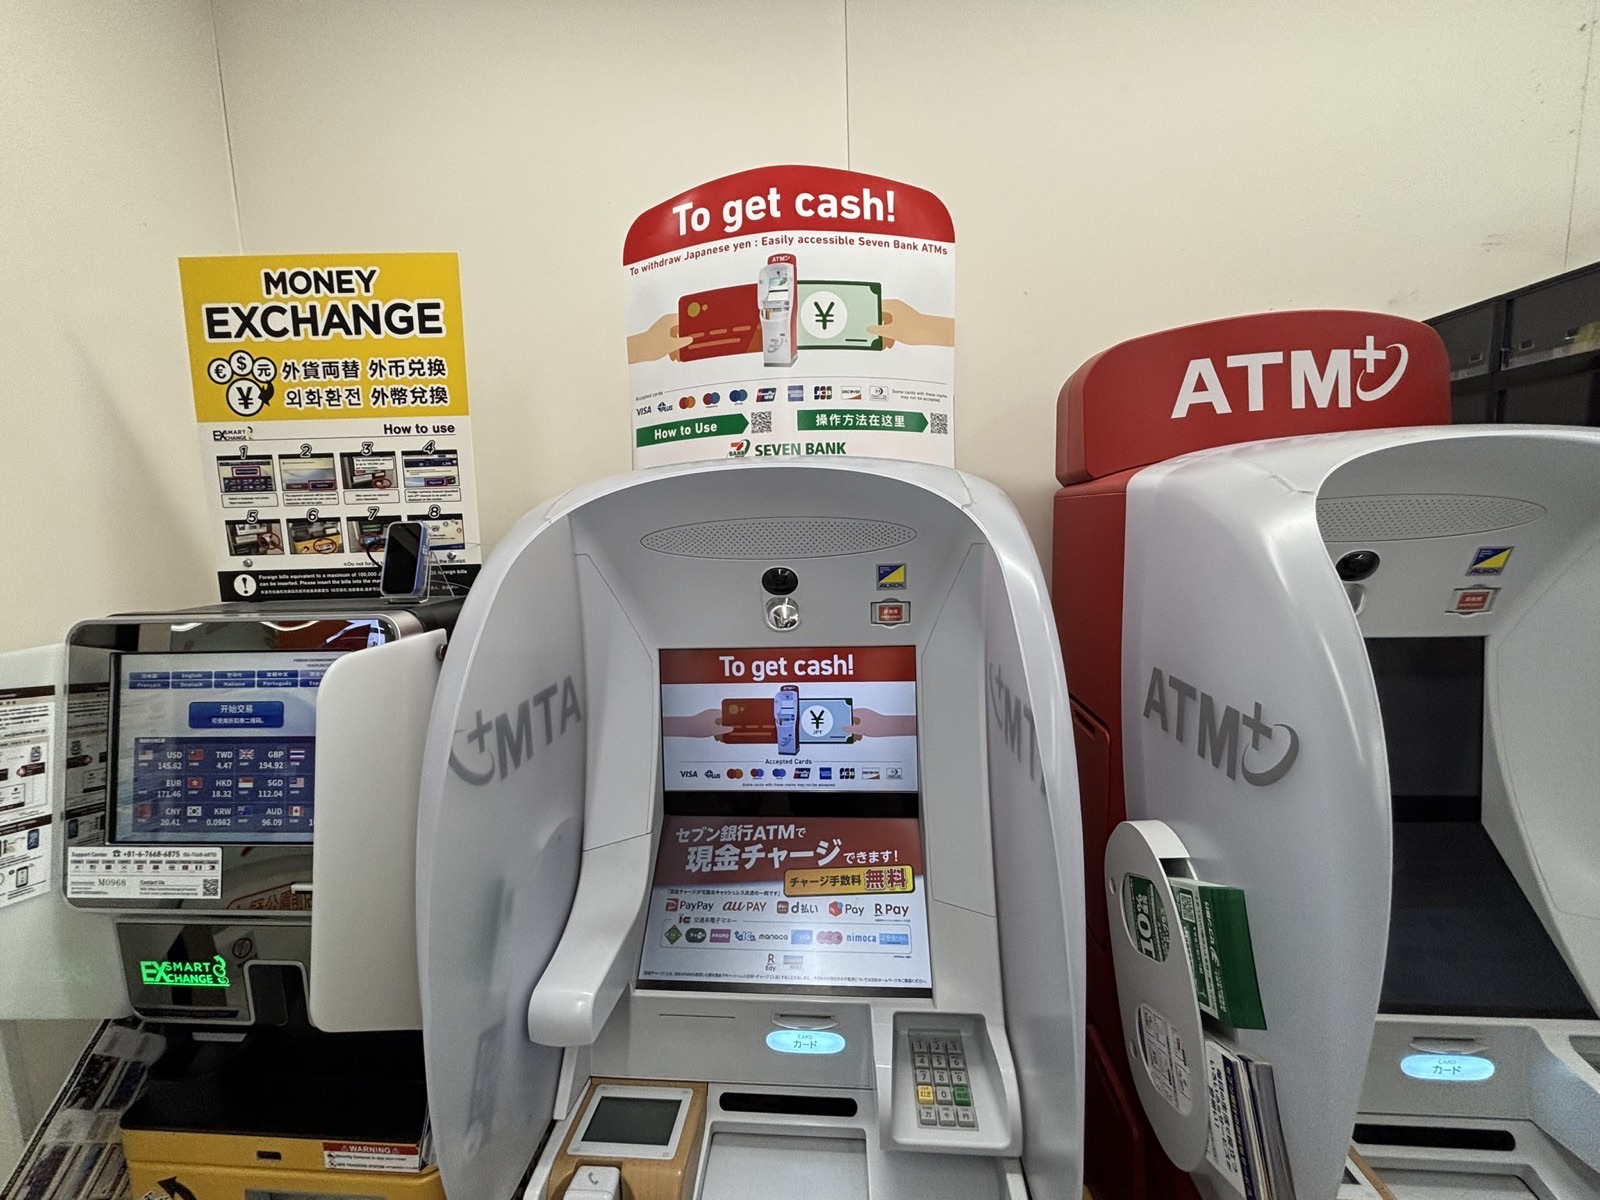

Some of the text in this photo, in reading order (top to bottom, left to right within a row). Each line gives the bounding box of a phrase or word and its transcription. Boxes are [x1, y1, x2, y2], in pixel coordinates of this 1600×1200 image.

[672, 187, 896, 237] To get cash!
[629, 267, 639, 277] To
[641, 254, 681, 274] withdraw
[684, 244, 730, 261] Japanese
[733, 239, 751, 253] yen
[762, 235, 794, 247] Easily
[797, 235, 855, 246] accessible
[858, 237, 889, 248] Seven
[893, 239, 919, 252] Bank
[921, 243, 948, 256] ATMs
[263, 269, 377, 295] MONEY
[205, 301, 443, 339] EXCHANGE
[282, 358, 447, 380] 外貨両替 外币兑换
[285, 387, 362, 408] 외화환전
[636, 406, 652, 416] VISA
[816, 414, 905, 428] 操作方法在这里
[384, 423, 455, 434] How to use
[654, 422, 718, 440] How to Use
[240, 440, 435, 459] 1 2 3 4
[755, 442, 846, 457] SEVEN BANK
[247, 505, 440, 523] 5 6 7 8
[719, 654, 854, 681] To get cash!
[263, 680, 292, 688] Português
[220, 705, 254, 714] 开始交易
[268, 751, 284, 759] GBP
[217, 762, 233, 770] 4.47
[259, 762, 284, 770] 194.92
[766, 758, 792, 766] Accepted
[680, 770, 698, 778] VISA
[675, 824, 806, 843] セブン銀行ATMで
[98, 879, 127, 887] M0968
[680, 901, 715, 912] PayPay
[747, 902, 767, 912] PAY
[791, 902, 819, 914] d払い
[845, 904, 865, 917] Pay
[886, 904, 910, 917] Pay
[847, 933, 877, 943] nimoca
[166, 962, 211, 973] SMART
[793, 1040, 818, 1049] カード
[1433, 1065, 1462, 1075] カード
[349, 1145, 391, 1154] WARNING
